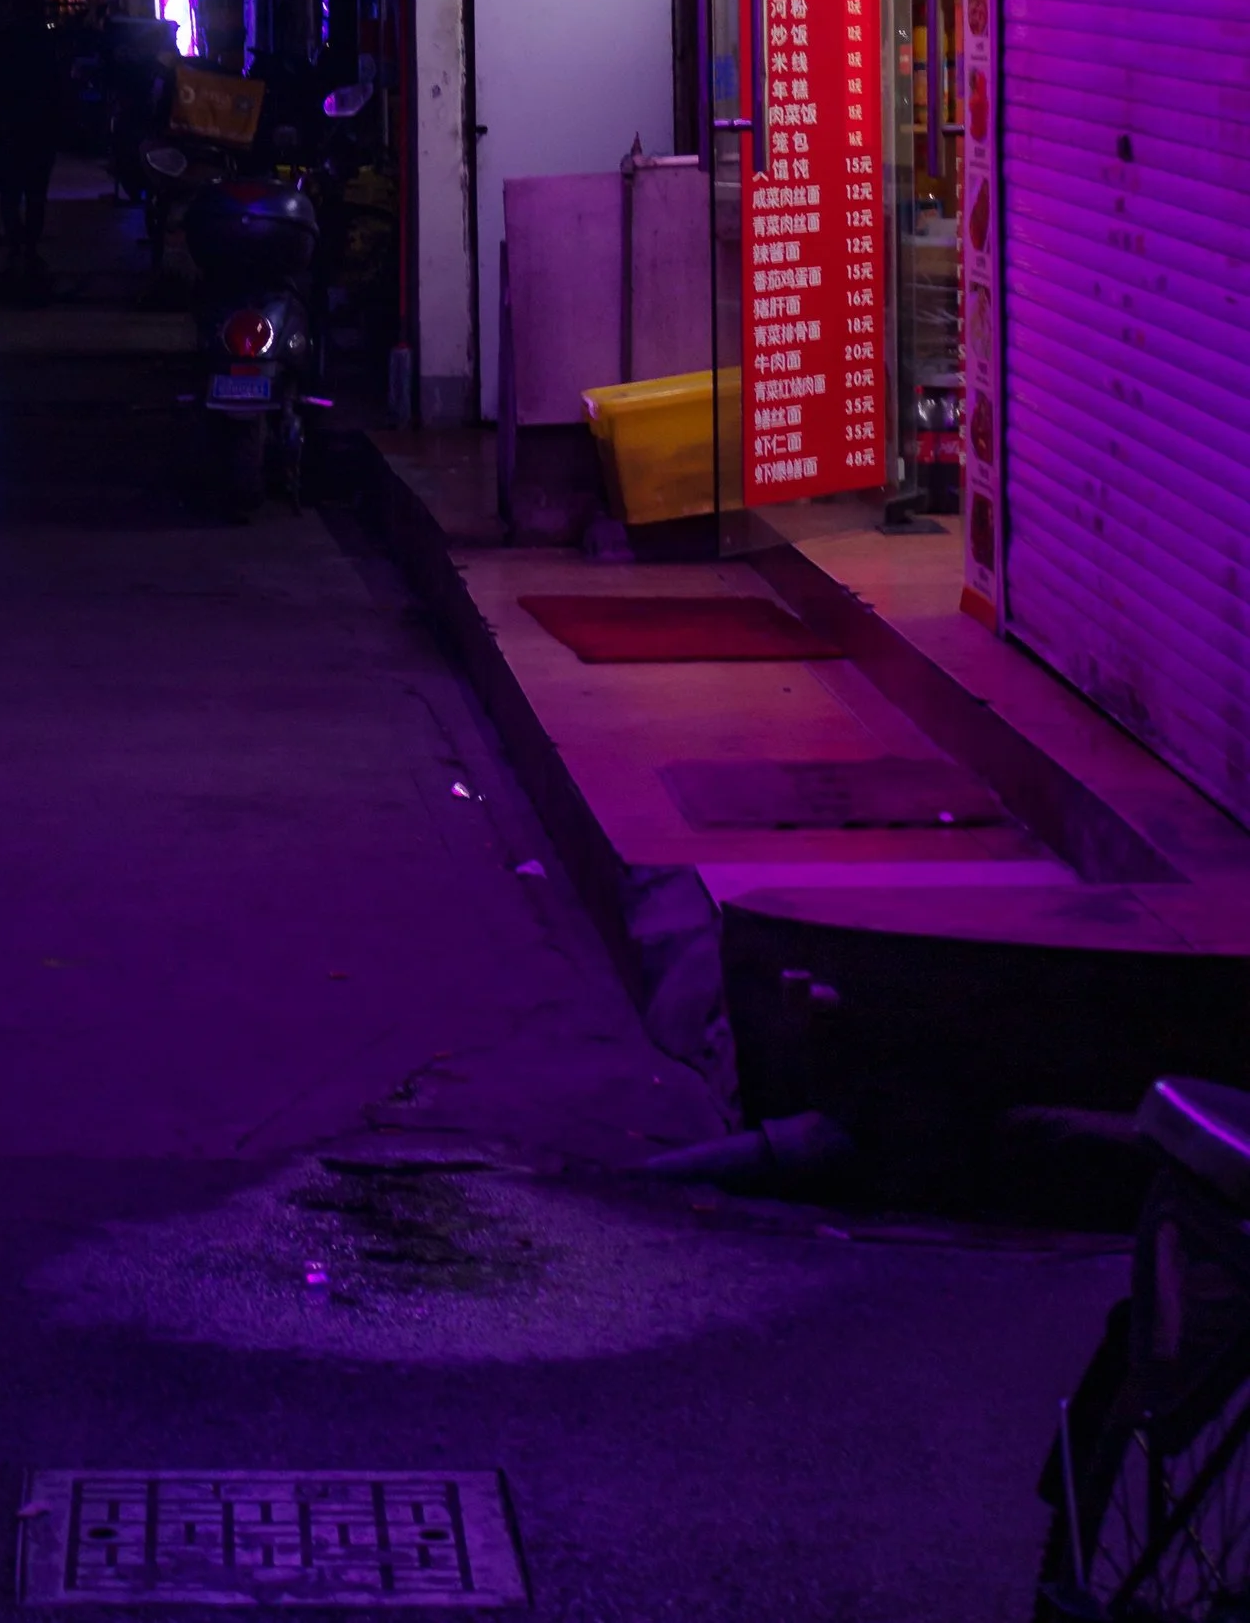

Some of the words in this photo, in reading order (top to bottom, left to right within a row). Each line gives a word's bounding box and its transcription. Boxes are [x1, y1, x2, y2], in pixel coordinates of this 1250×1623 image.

[846, 155, 874, 174] 15元
[846, 182, 874, 200] 12元
[753, 212, 820, 237] 青菜肉丝面
[846, 208, 874, 227] 12元
[753, 241, 800, 266] 辣酱面
[846, 235, 874, 254] 12元
[753, 266, 822, 292] 番茄鸡蛋面
[846, 261, 874, 280] 15元
[753, 295, 801, 320] 猪肝面
[846, 288, 874, 307] 16元
[753, 320, 821, 348] 青菜排骨面
[846, 315, 874, 334] 18元
[754, 350, 801, 375] 牛肉面
[845, 341, 875, 361] 20元
[754, 374, 826, 403] 青菜红烧肉面
[845, 368, 875, 387] 20元
[845, 395, 875, 415] 35元
[754, 432, 802, 457] 虾仁面
[845, 421, 875, 441] 35元
[846, 448, 876, 467] 48元
